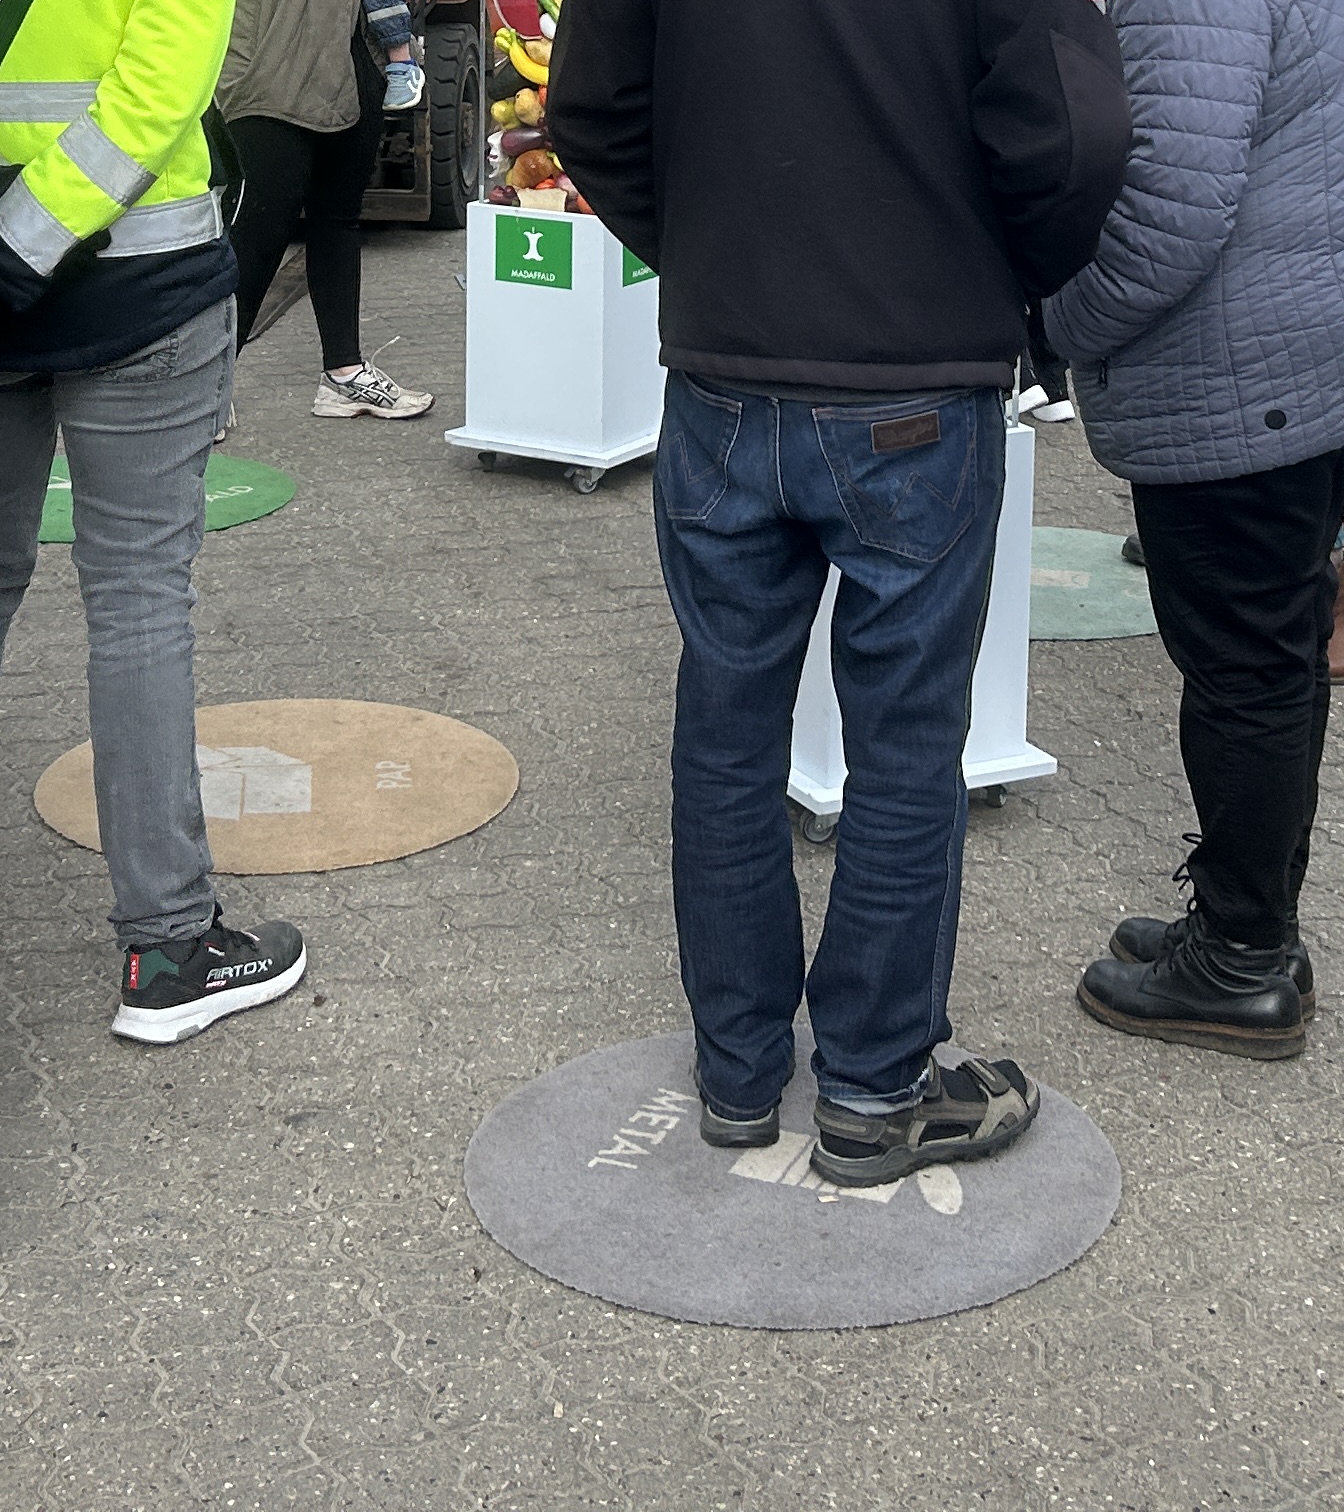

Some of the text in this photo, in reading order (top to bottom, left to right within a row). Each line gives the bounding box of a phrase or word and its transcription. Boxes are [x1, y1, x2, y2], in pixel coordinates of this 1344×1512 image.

[510, 268, 556, 283] MADAFFALD
[375, 760, 413, 790] PAP
[207, 960, 269, 981] AIRTOX
[587, 1087, 700, 1170] METAL
